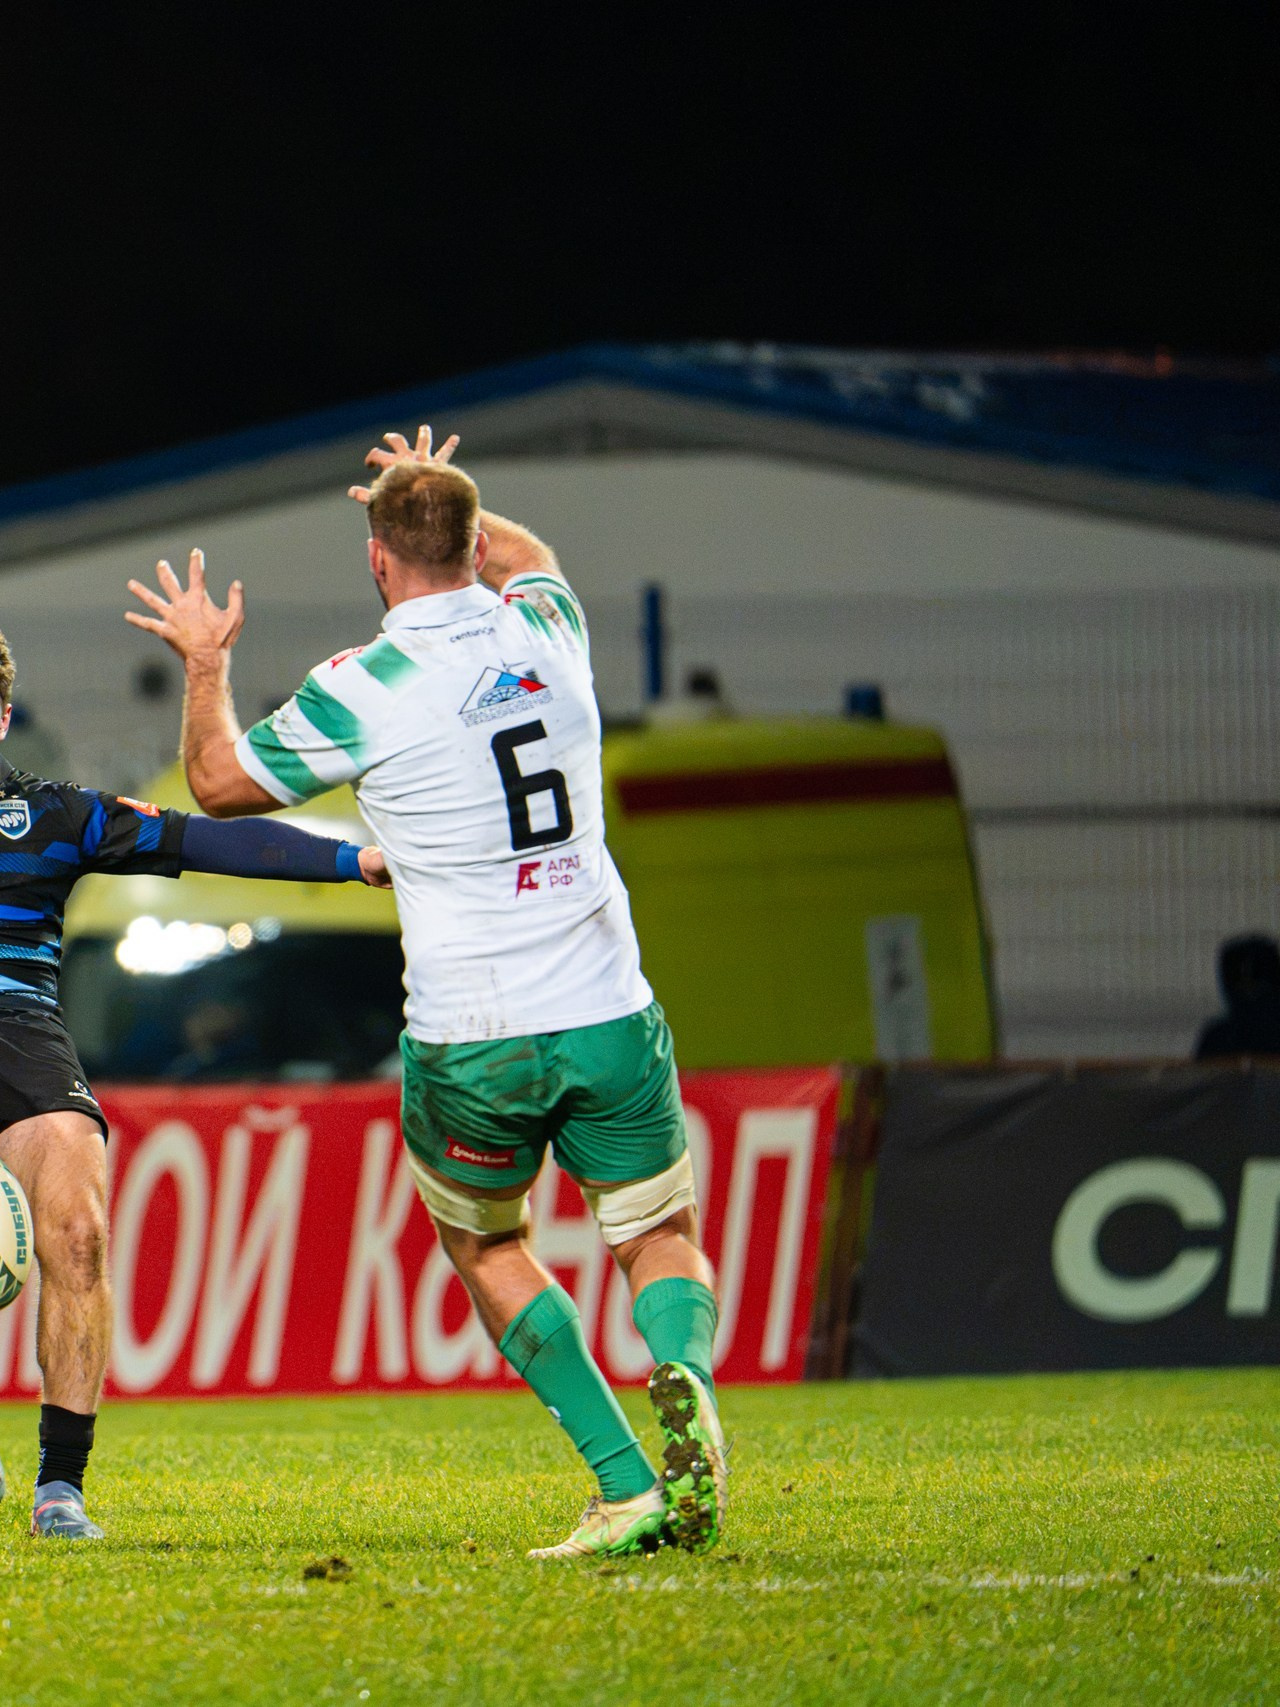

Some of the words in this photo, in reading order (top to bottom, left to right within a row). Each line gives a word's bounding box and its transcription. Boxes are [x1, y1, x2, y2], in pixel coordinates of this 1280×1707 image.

[491, 719, 573, 851] 6
[547, 855, 580, 873] АГАТ
[549, 874, 573, 888] РФ
[0, 1181, 27, 1265] СИБУР
